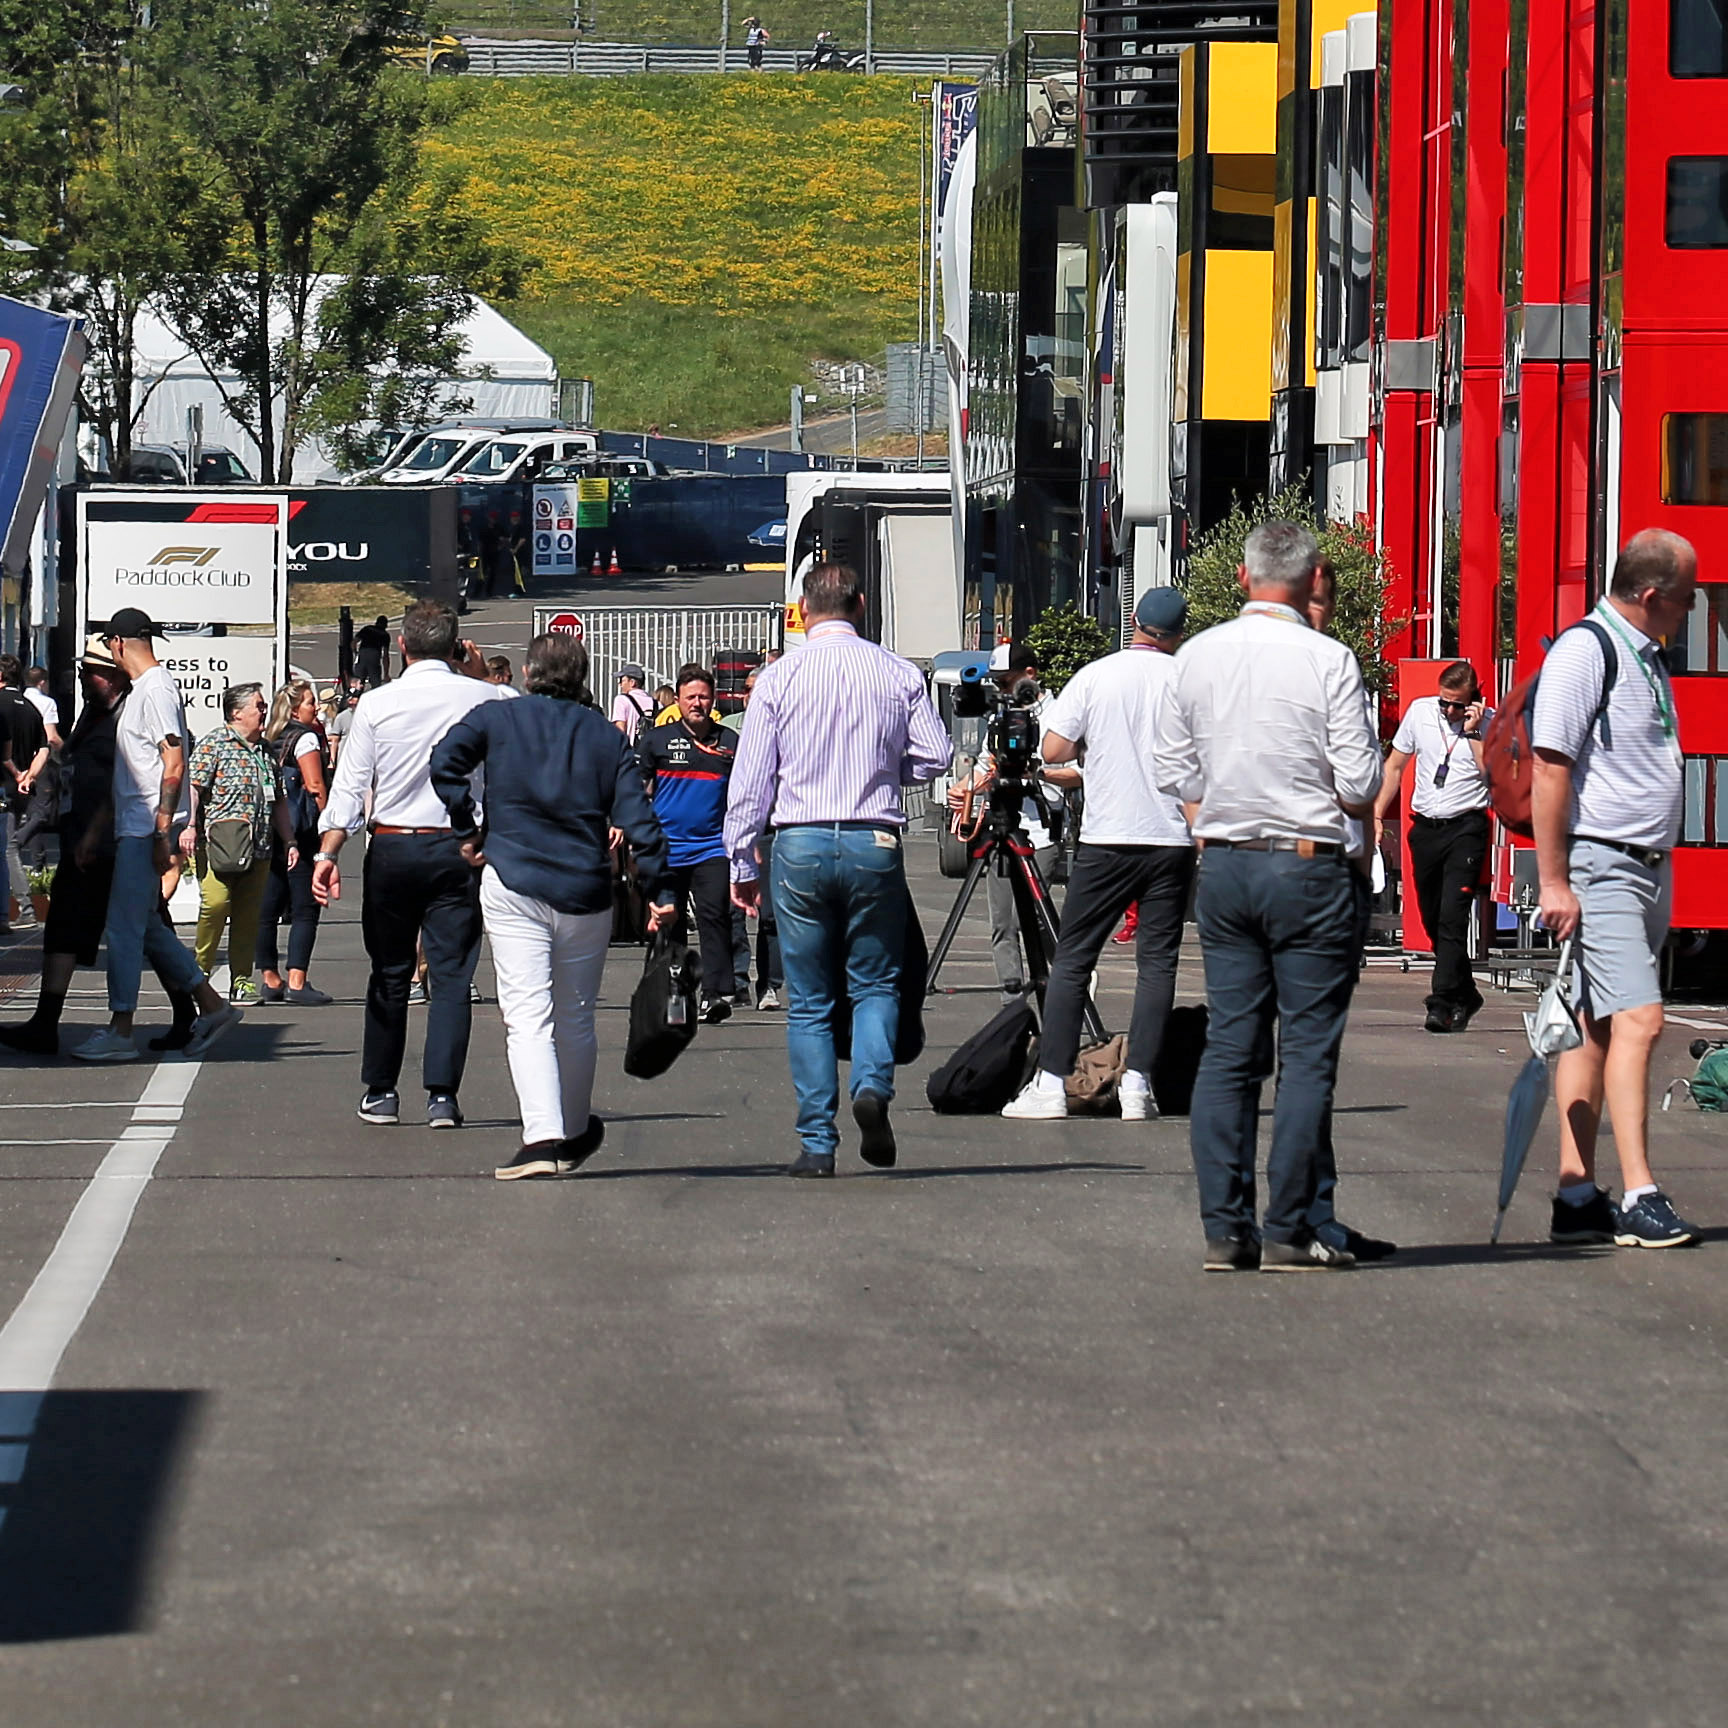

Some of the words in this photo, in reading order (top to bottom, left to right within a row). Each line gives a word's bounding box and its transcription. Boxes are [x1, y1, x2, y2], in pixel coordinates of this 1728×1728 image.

[286, 542, 369, 561] YOU
[115, 568, 204, 587] Paddock
[206, 569, 251, 588] Club
[550, 624, 582, 638] STOP
[208, 656, 228, 672] to
